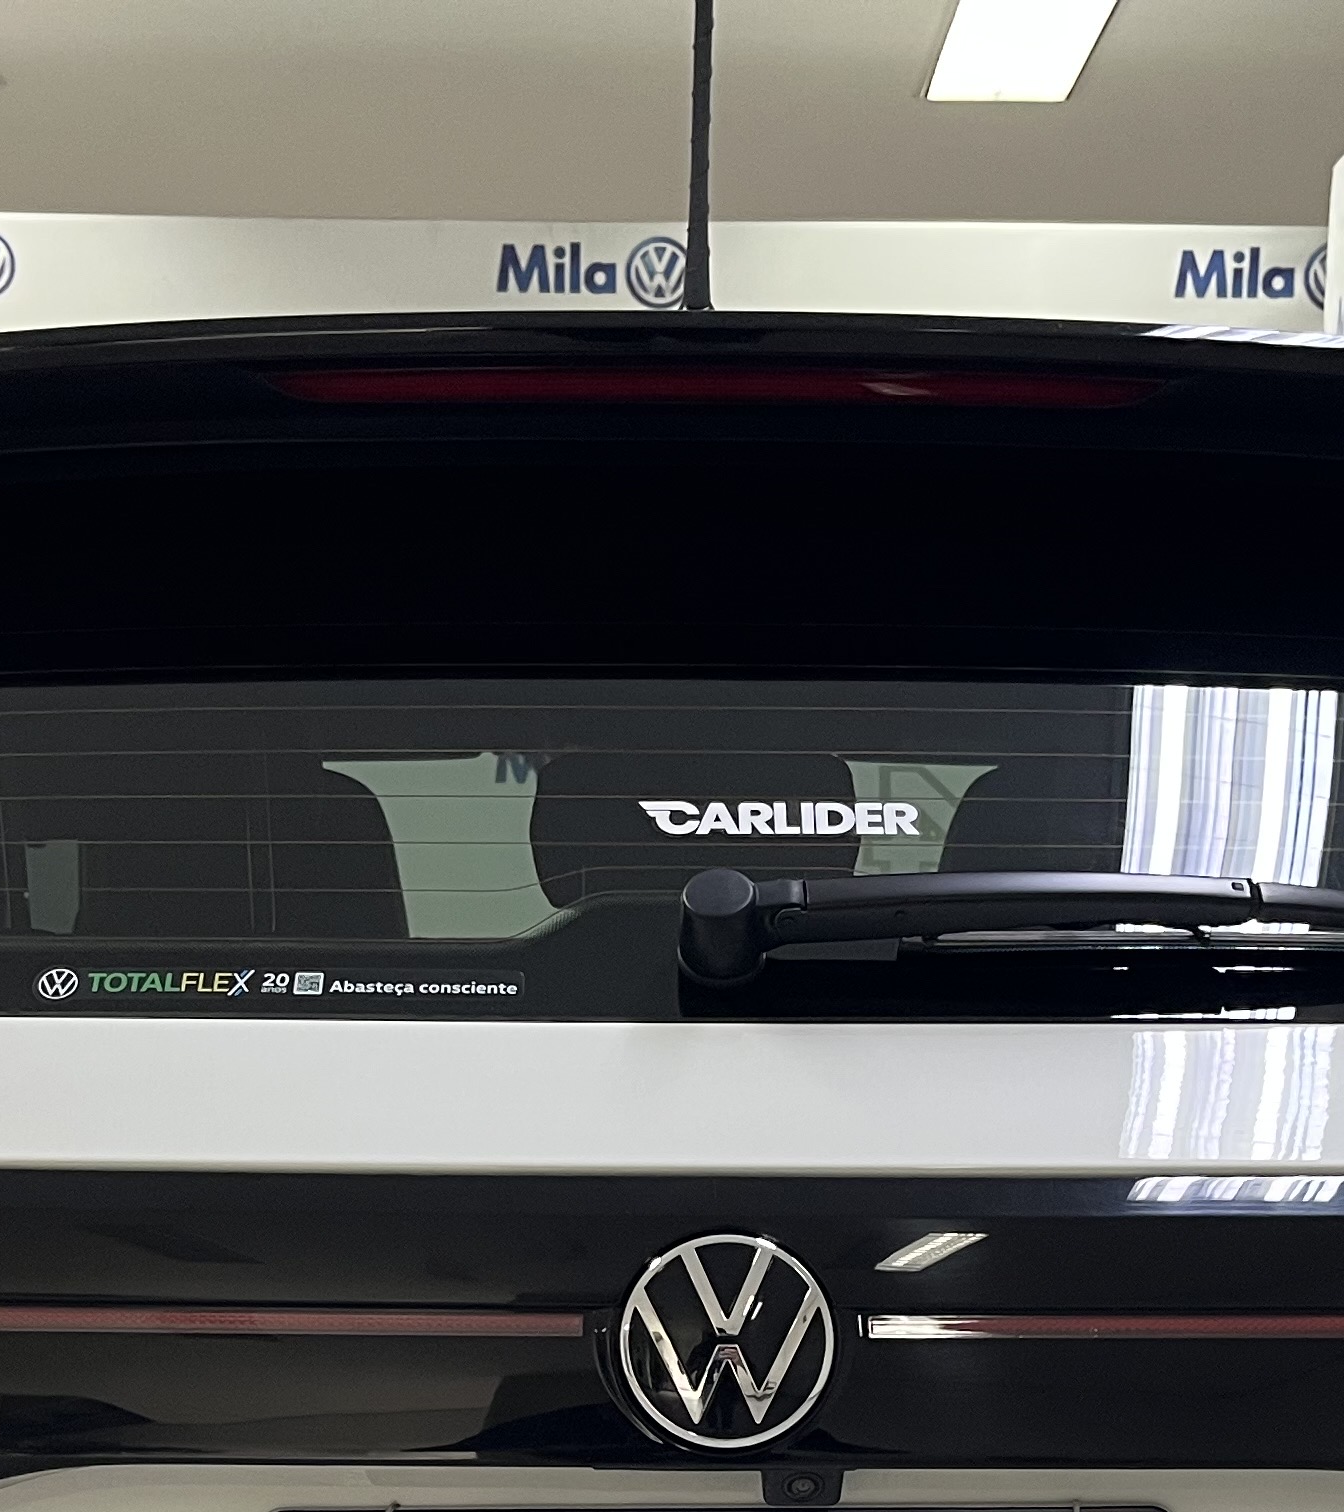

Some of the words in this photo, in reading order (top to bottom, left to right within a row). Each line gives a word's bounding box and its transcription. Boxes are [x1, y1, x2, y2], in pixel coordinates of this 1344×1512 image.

[497, 241, 617, 294] Mila
[1174, 247, 1295, 299] Mila
[638, 800, 920, 836] CARLIDER
[88, 969, 255, 996] TOTALFLEX
[262, 972, 290, 987] 20
[329, 980, 415, 996] Abasteça
[419, 980, 519, 995] consciente
[620, 1234, 835, 1448] VW
